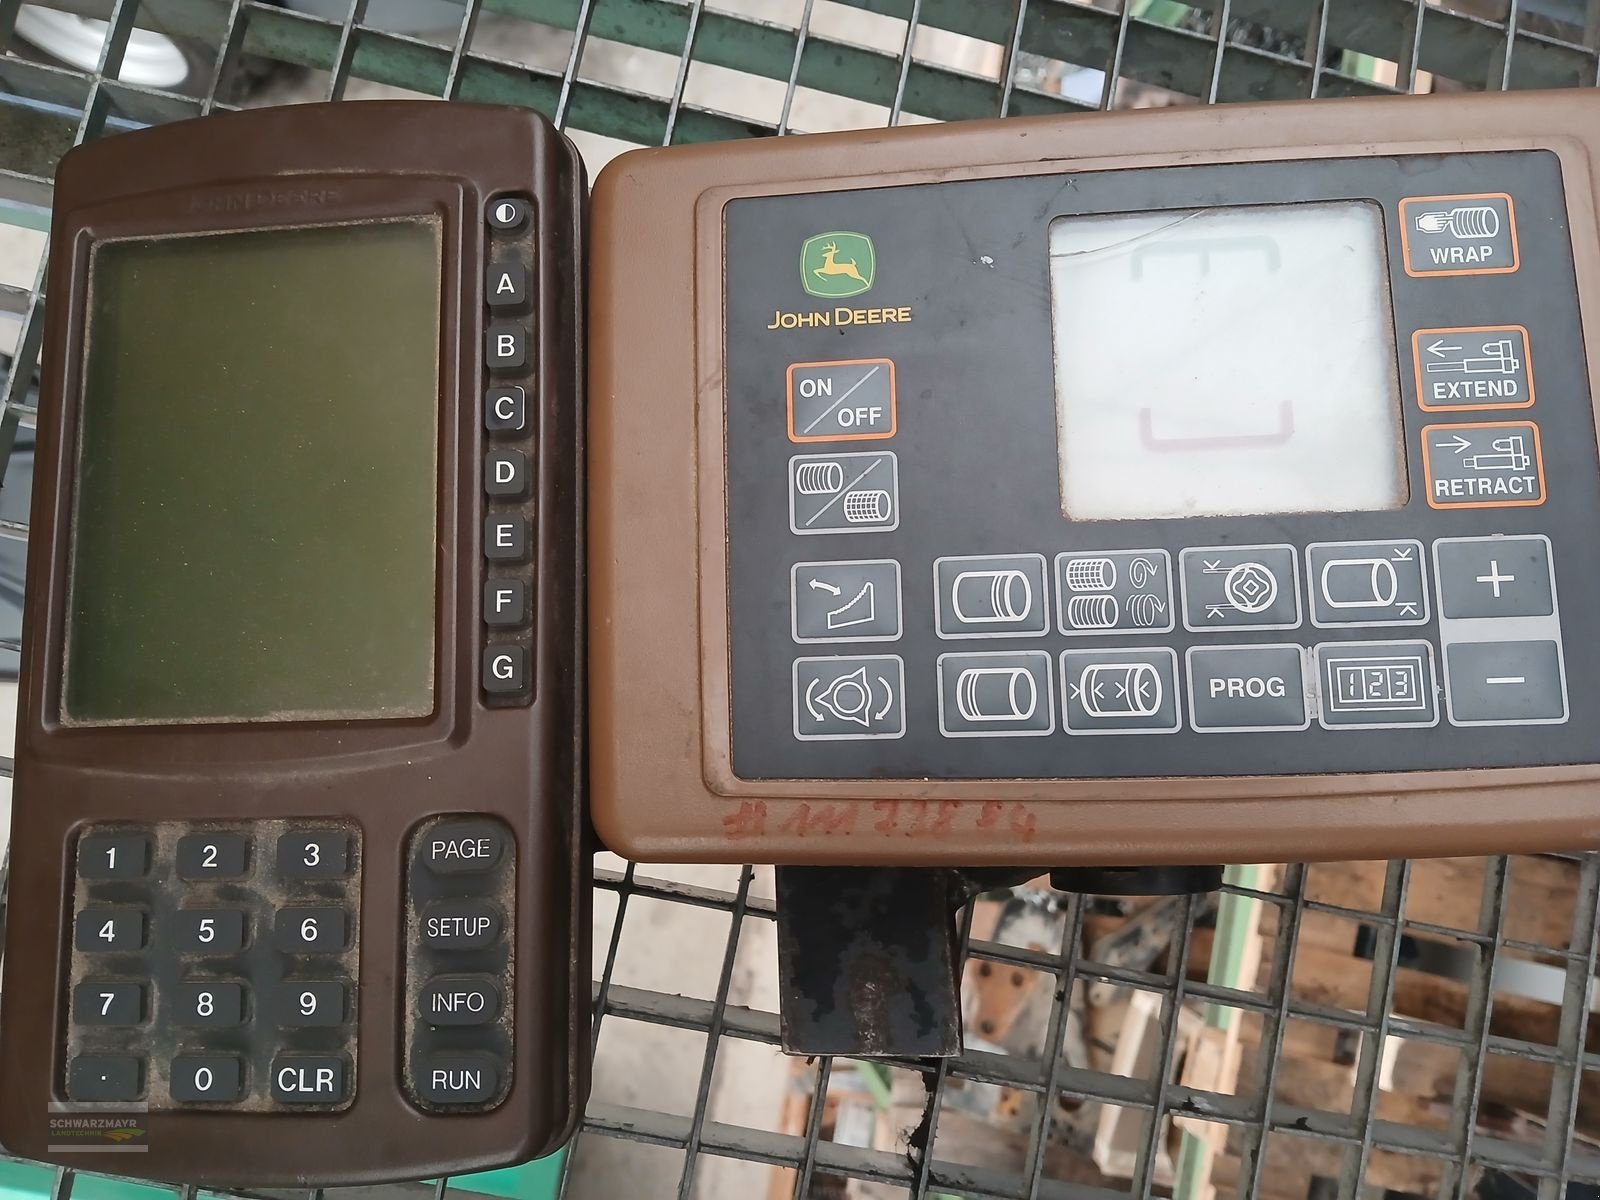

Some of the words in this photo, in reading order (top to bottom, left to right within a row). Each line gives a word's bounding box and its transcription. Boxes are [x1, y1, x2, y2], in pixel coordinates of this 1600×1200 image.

[1429, 245, 1494, 265] WRAP
[496, 273, 515, 294] A
[767, 310, 830, 330] JOHN
[833, 306, 912, 327] DEERE
[496, 334, 516, 357] B
[799, 378, 833, 398] ON
[1432, 379, 1519, 399] EXTEND
[494, 396, 515, 420] C
[836, 406, 883, 427] OFF
[494, 460, 516, 483] D
[1434, 476, 1536, 497] RETRACT
[496, 524, 514, 547] E
[495, 589, 513, 613] F
[491, 654, 514, 680] G
[1209, 676, 1287, 699] PROG
[105, 847, 117, 869] 1
[201, 845, 218, 868] 2
[303, 843, 320, 867] 3
[431, 838, 491, 860] PAGE
[98, 920, 116, 942] 4
[198, 919, 215, 942] 5
[301, 918, 318, 941] 6
[427, 917, 491, 937] SETUP
[99, 993, 115, 1016] 7
[196, 992, 214, 1016] 8
[299, 992, 317, 1015] 9
[431, 992, 485, 1012] INFO
[194, 1067, 213, 1091] 0
[277, 1067, 335, 1092] CLR
[431, 1070, 481, 1090] RUN
